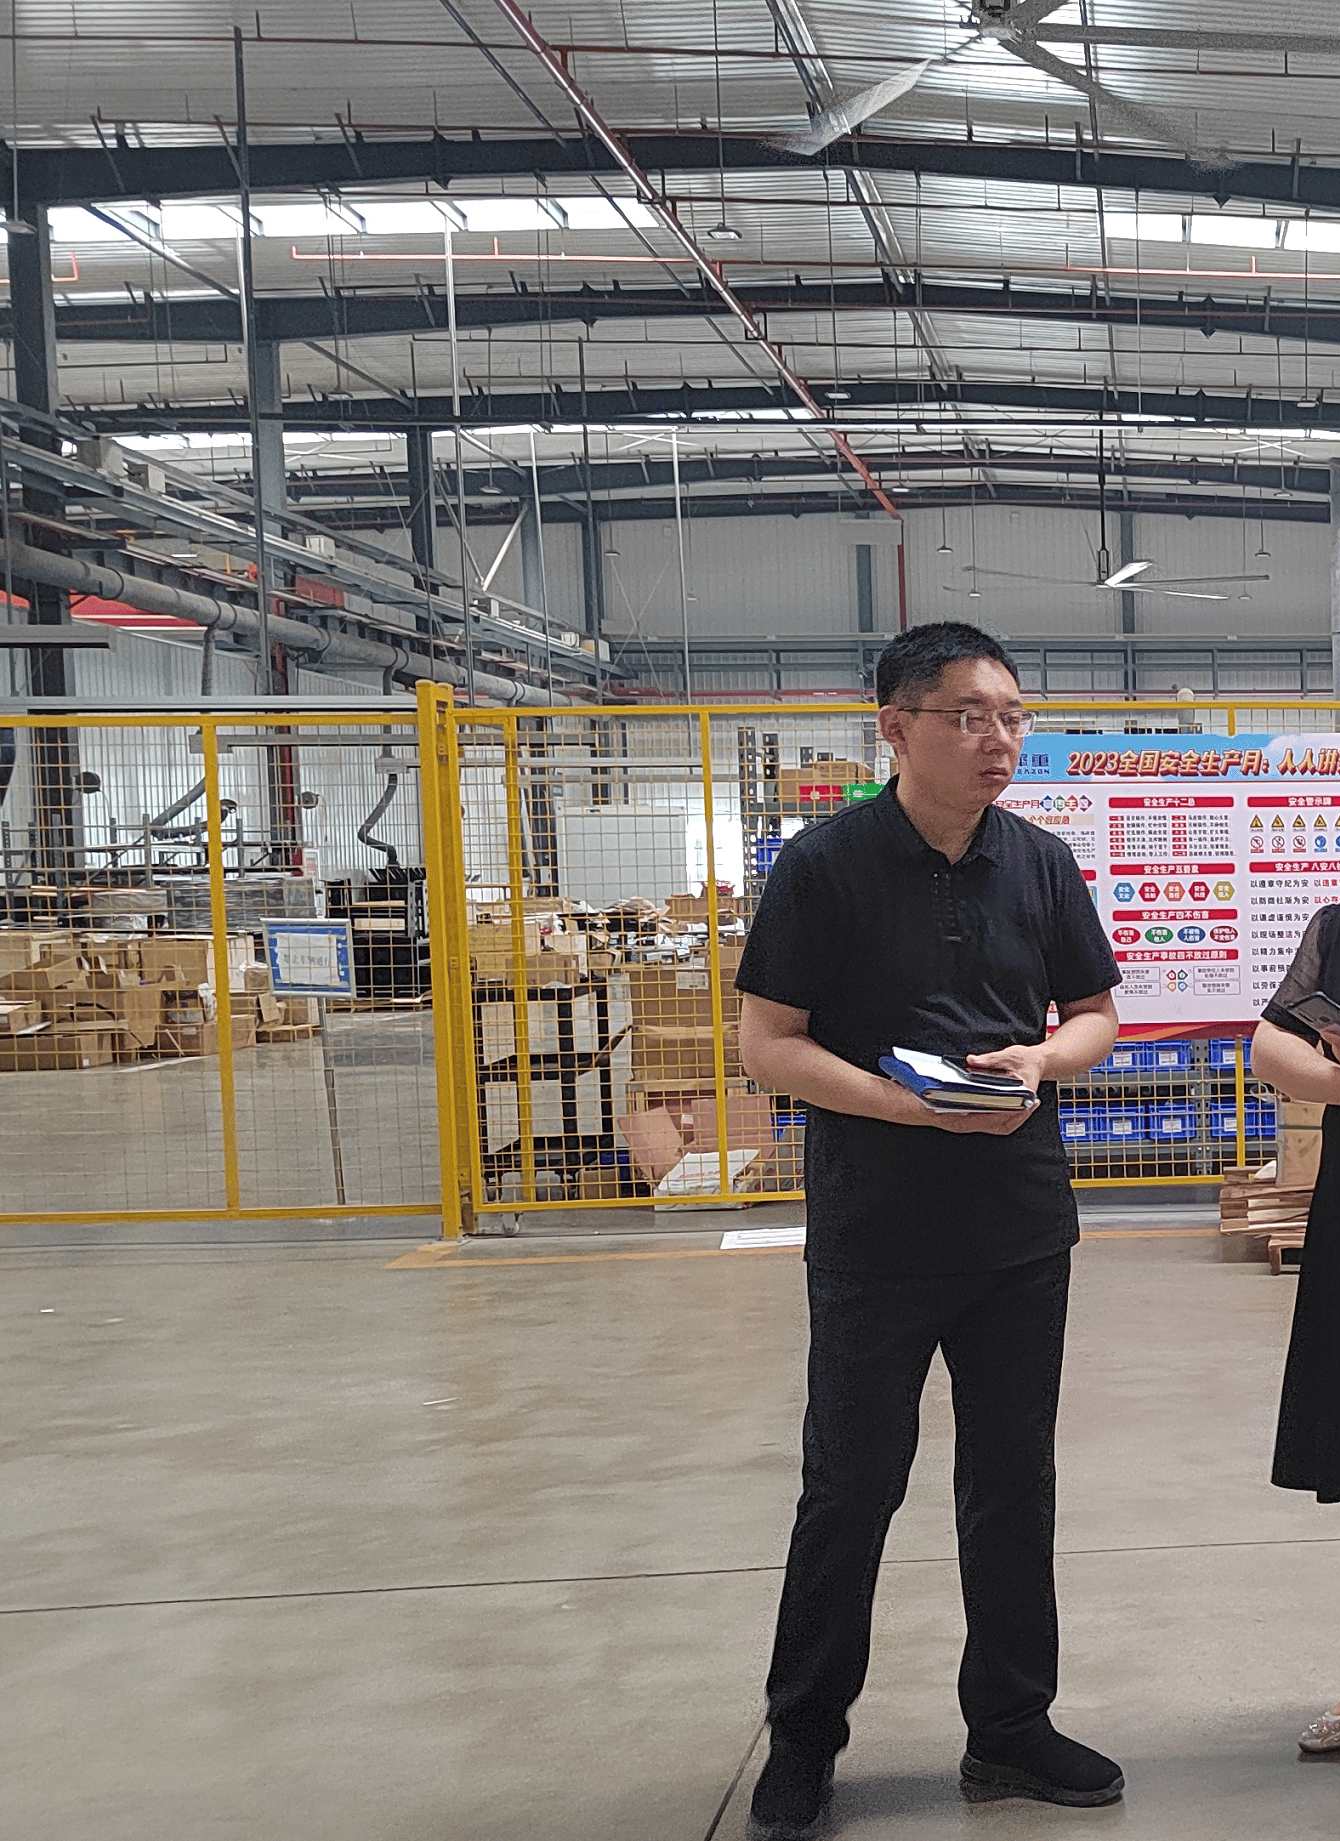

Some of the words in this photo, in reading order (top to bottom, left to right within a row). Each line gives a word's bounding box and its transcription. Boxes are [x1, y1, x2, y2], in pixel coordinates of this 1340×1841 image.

[1252, 947, 1297, 956] 以精力集中
[1252, 981, 1281, 990] 以劳保
